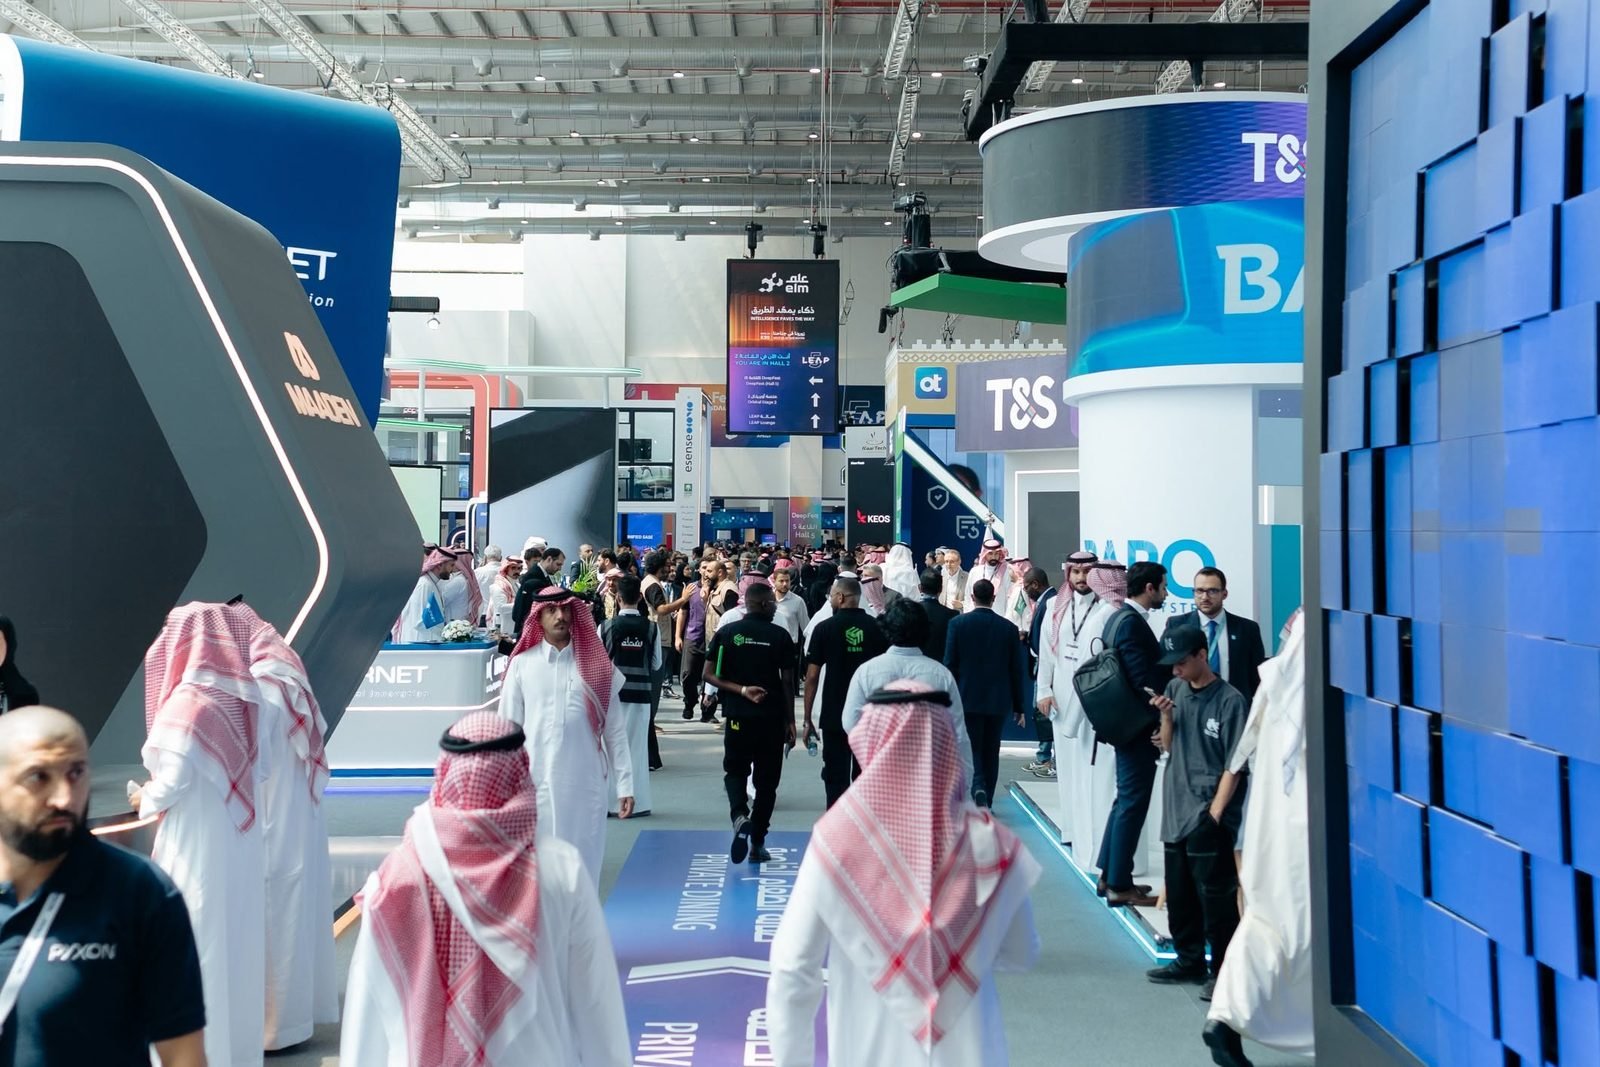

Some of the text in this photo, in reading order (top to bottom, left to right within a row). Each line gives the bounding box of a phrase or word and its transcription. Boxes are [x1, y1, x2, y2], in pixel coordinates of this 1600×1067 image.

[1242, 133, 1306, 183] T&
[286, 247, 337, 280] ET
[309, 293, 334, 307] ion
[785, 284, 809, 293] elm
[986, 375, 1057, 432] T&S
[685, 434, 693, 473] esense
[867, 515, 891, 523] KEOS
[672, 854, 729, 931] PRIVATE DINING
[633, 1022, 699, 1067] PRIV
